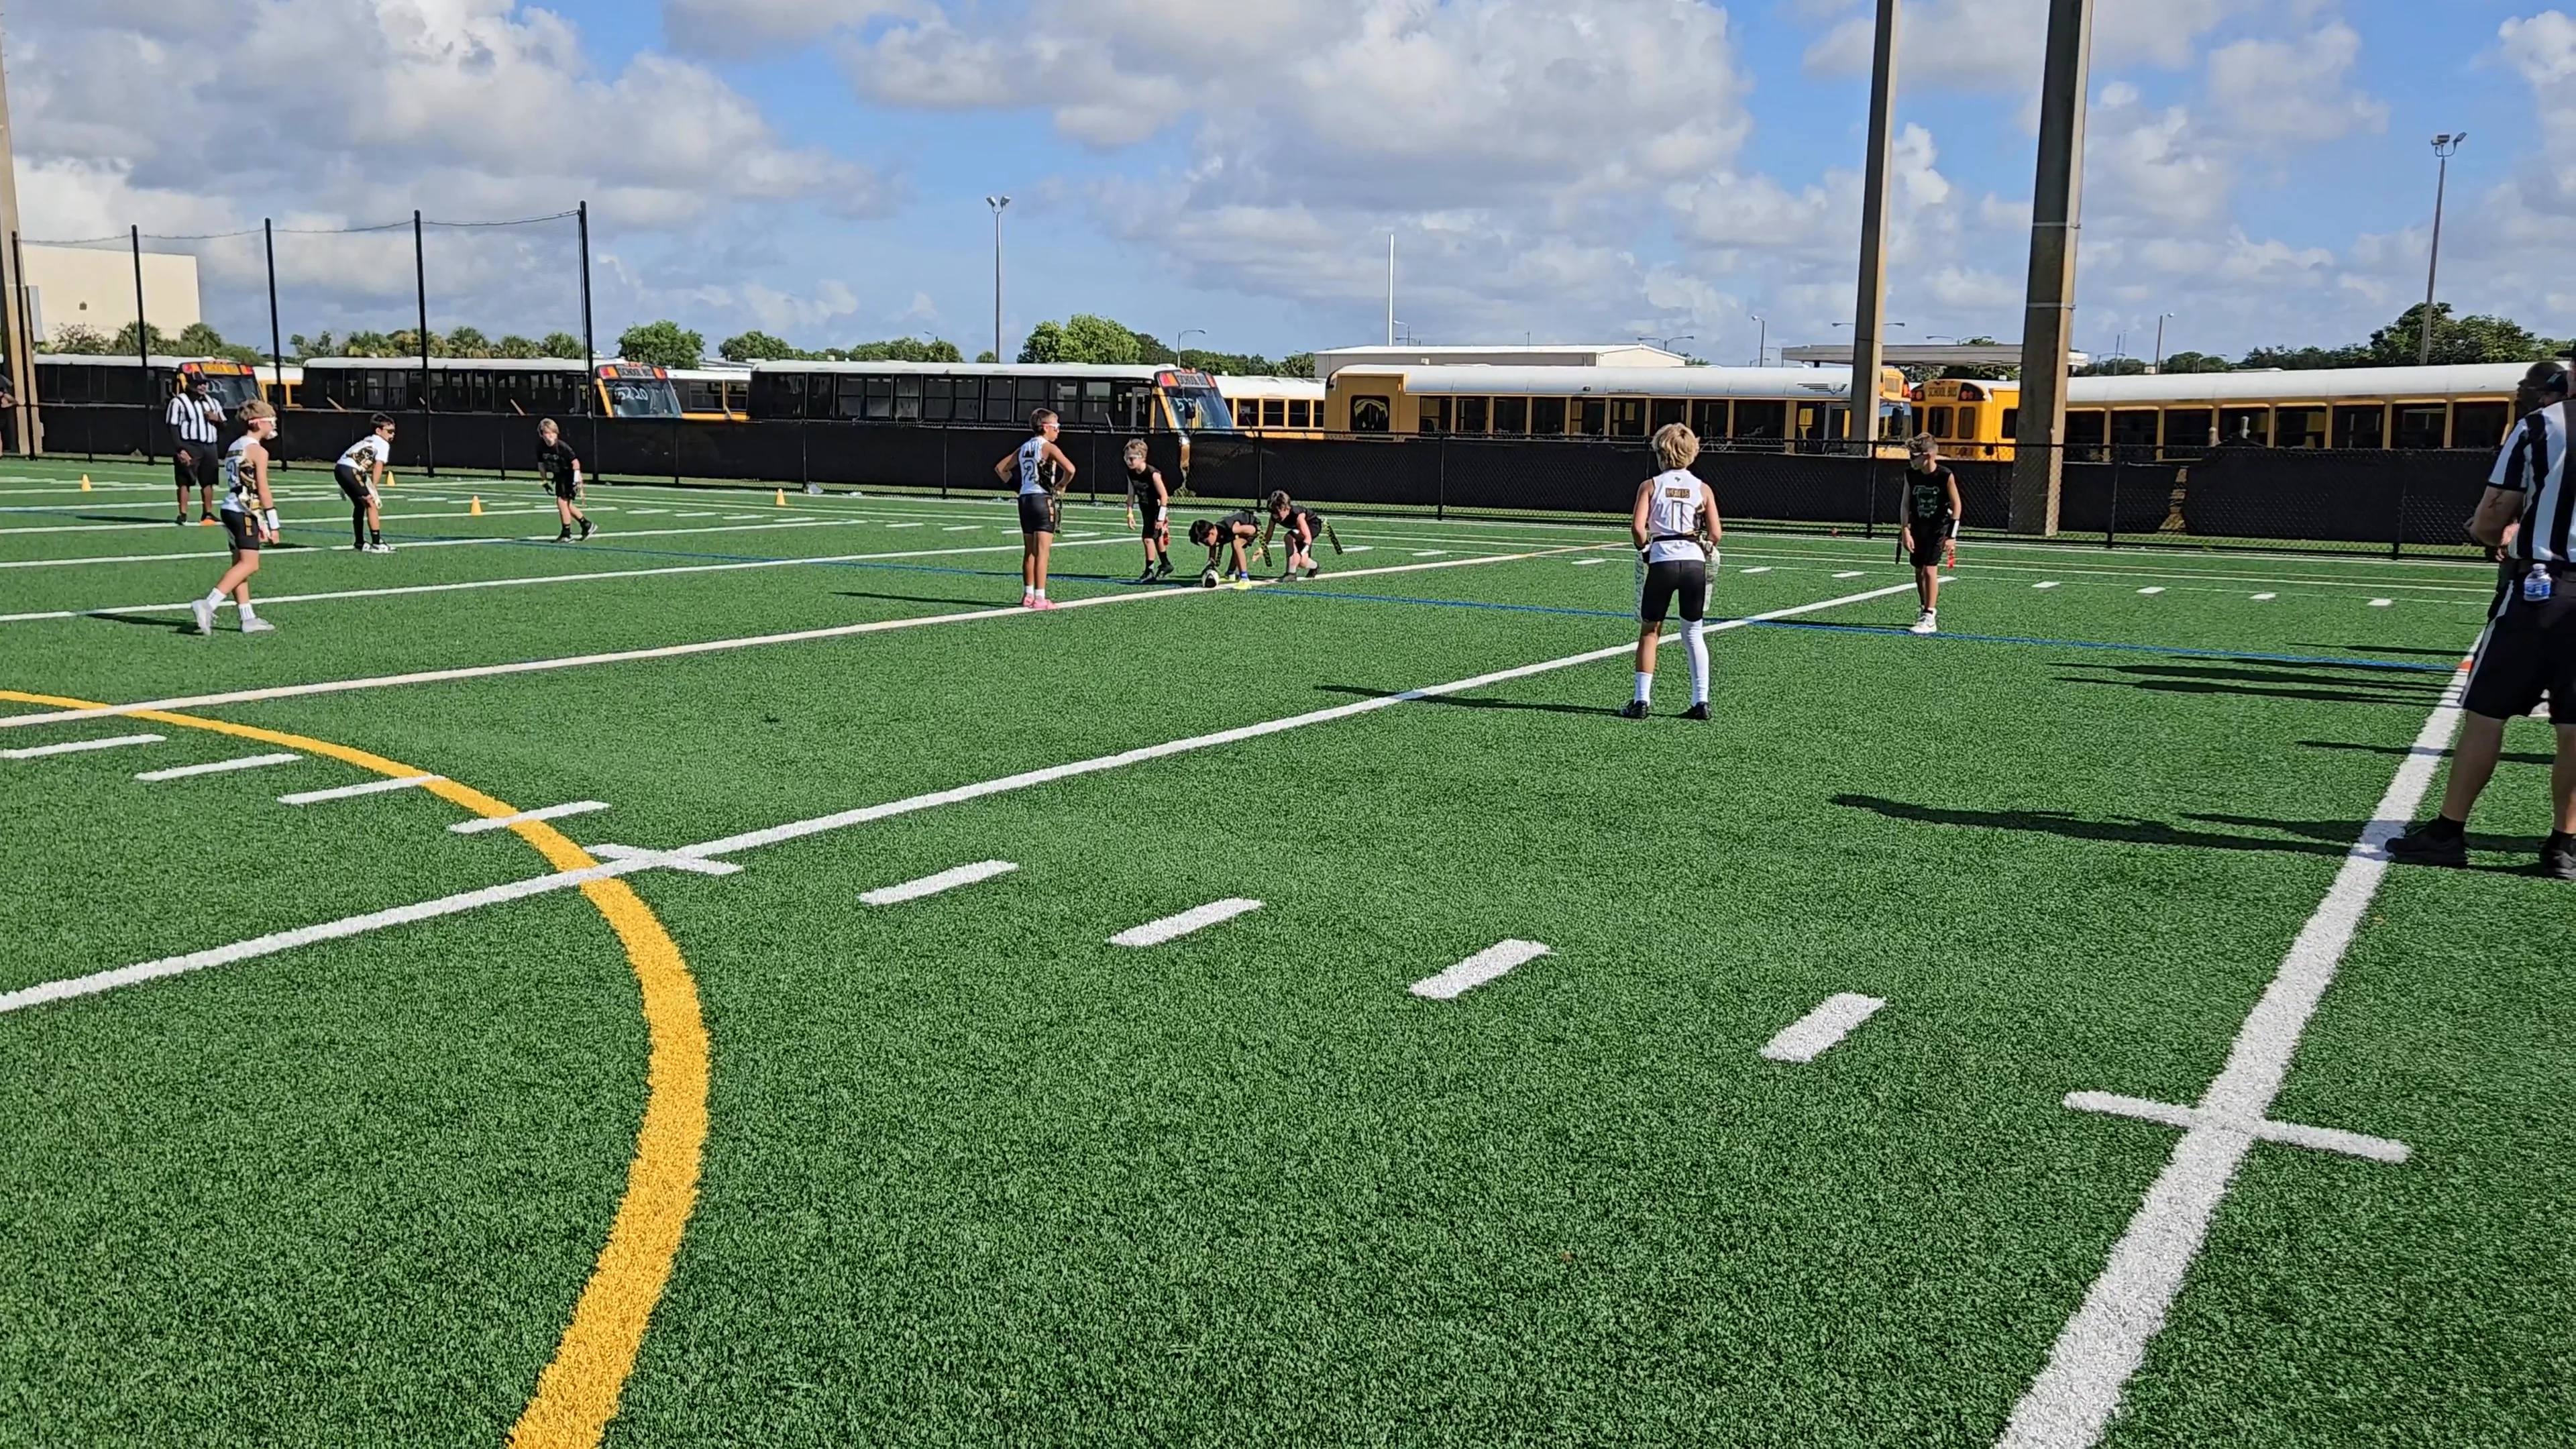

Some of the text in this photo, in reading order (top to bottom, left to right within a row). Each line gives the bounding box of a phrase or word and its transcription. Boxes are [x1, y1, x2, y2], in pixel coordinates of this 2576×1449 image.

[617, 368, 643, 376] SCHOOL
[1176, 374, 1199, 385] SCHOOL
[1927, 386, 1957, 397] SCHOOL BUS
